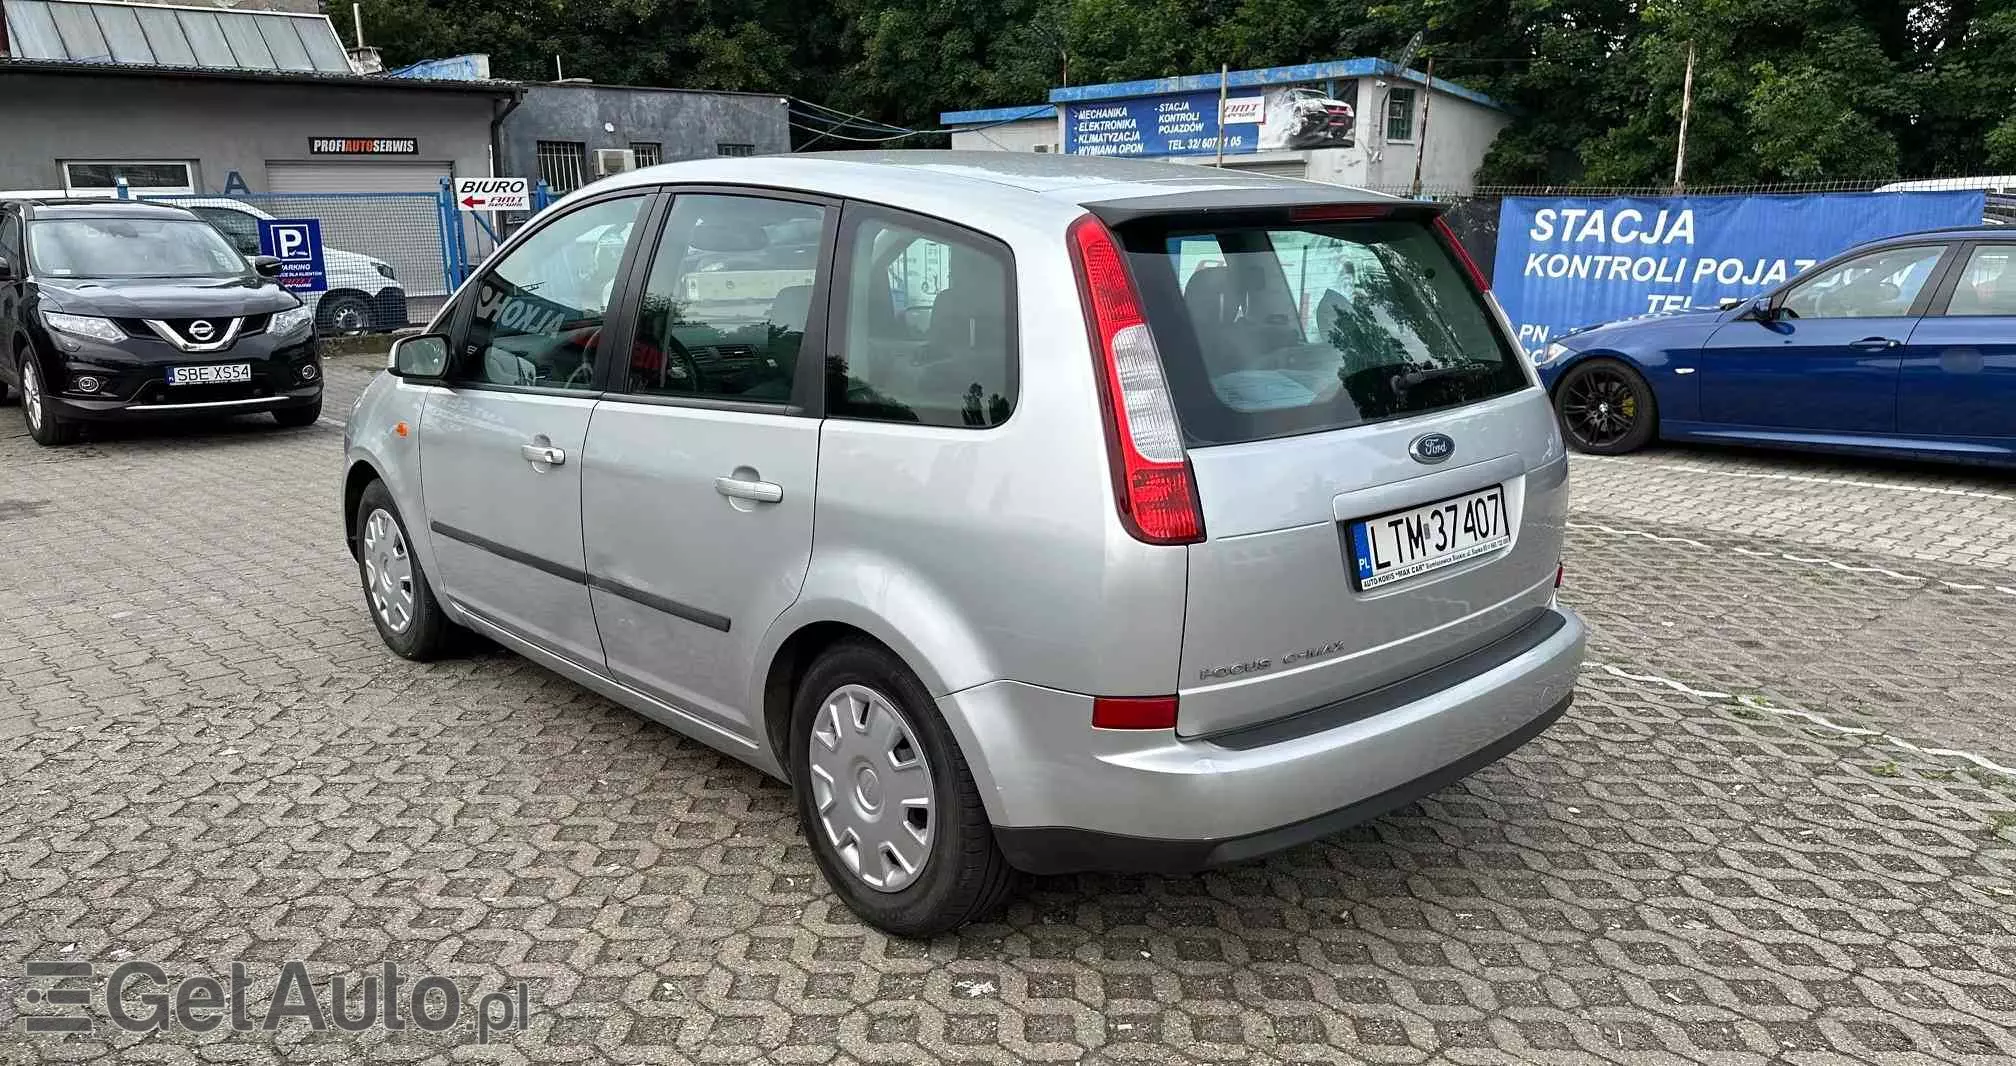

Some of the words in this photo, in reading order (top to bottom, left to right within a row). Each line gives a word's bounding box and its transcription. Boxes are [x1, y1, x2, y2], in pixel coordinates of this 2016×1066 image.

[1079, 106, 1128, 119] MECHANIKA
[1159, 101, 1190, 113] STACJA
[1158, 111, 1200, 123] KONTROLI
[1078, 118, 1137, 131] ELEKTRONIKA
[1158, 121, 1205, 134] POJAZDÓW
[1078, 130, 1140, 143] KLIMATYZACJA
[1168, 139, 1186, 150] TEL.
[1230, 136, 1242, 146] 05
[313, 139, 414, 152] PROFIAUTOSERWIS
[1078, 145, 1118, 156] WYMIANA
[1119, 143, 1144, 154] OPON
[460, 181, 525, 193] BIURO
[1530, 208, 1695, 244] STACJA
[279, 229, 302, 257] P
[1524, 253, 1687, 282] KONTROLI
[1519, 324, 1550, 343] PN
[178, 368, 209, 380] SBE
[215, 365, 249, 379] XS54
[1425, 439, 1447, 455] Ford
[1370, 514, 1426, 570] LTM
[1430, 493, 1499, 551] 37407
[1358, 559, 1371, 571] PL
[1200, 657, 1272, 680] FOCUS
[1282, 640, 1345, 665] C-MAX
